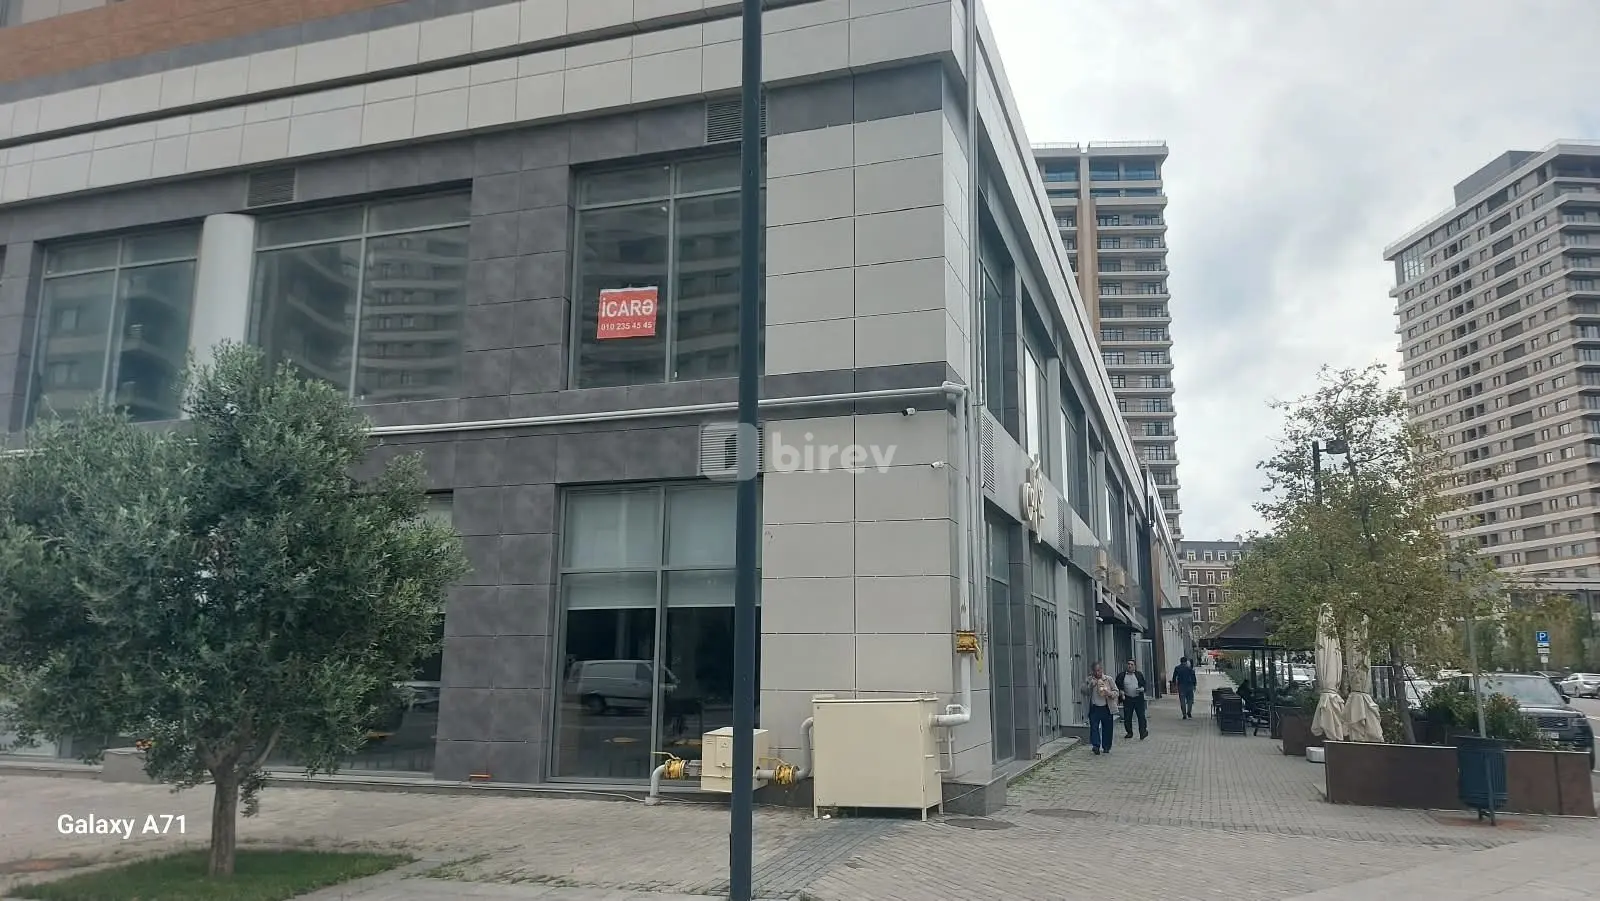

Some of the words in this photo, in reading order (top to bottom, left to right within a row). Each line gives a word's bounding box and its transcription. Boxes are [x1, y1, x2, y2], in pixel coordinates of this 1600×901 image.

[601, 323, 615, 331] 010
[616, 322, 631, 330] 235
[643, 321, 653, 329] 45
[1539, 632, 1546, 641] P
